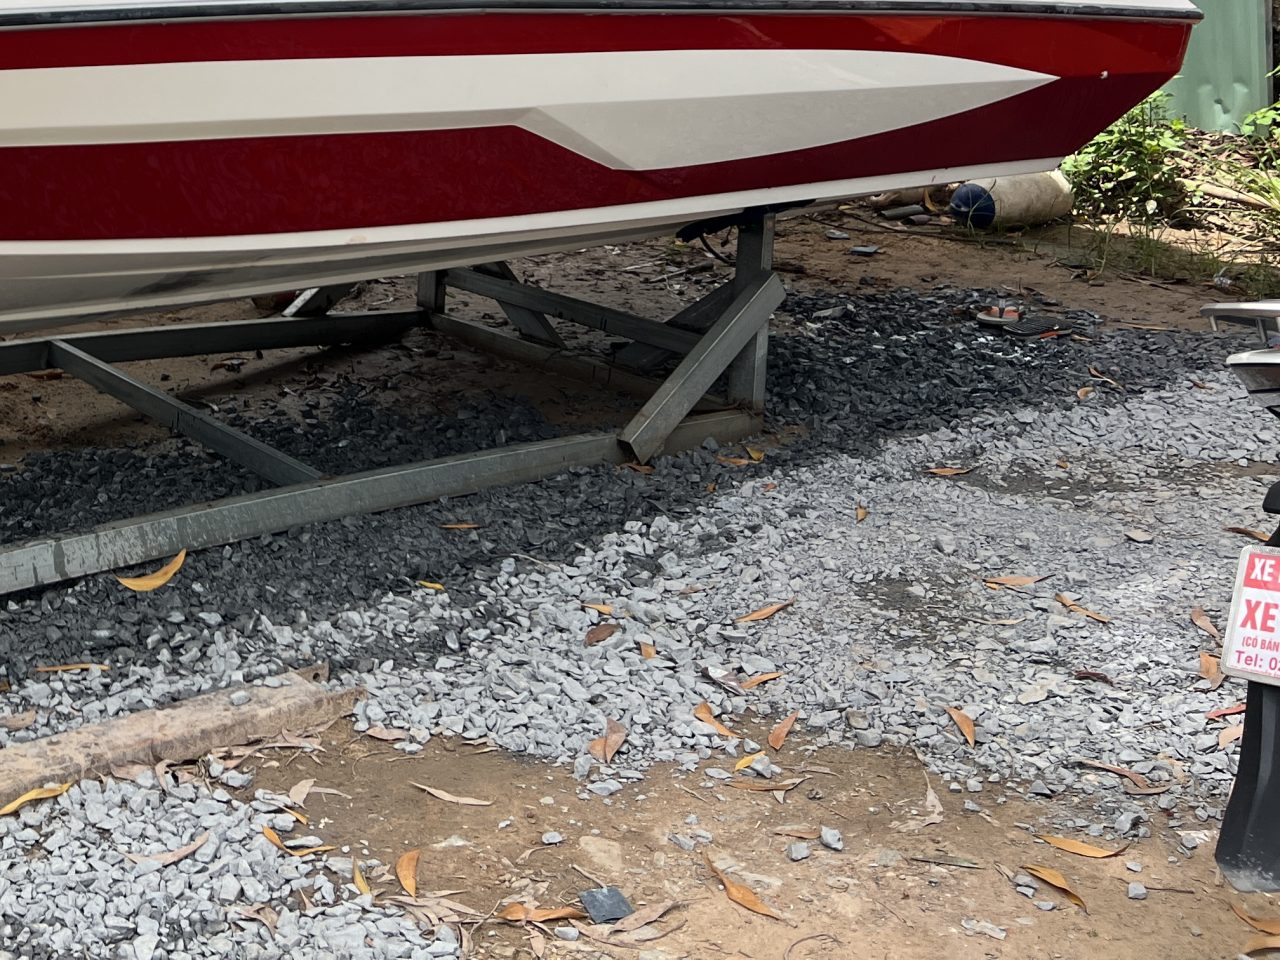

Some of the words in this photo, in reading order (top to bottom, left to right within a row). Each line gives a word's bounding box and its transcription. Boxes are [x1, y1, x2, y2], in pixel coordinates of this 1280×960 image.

[1250, 557, 1275, 582] XE
[1240, 599, 1279, 633] XE
[1235, 650, 1263, 668] Tel:
[1269, 657, 1280, 672] 0
